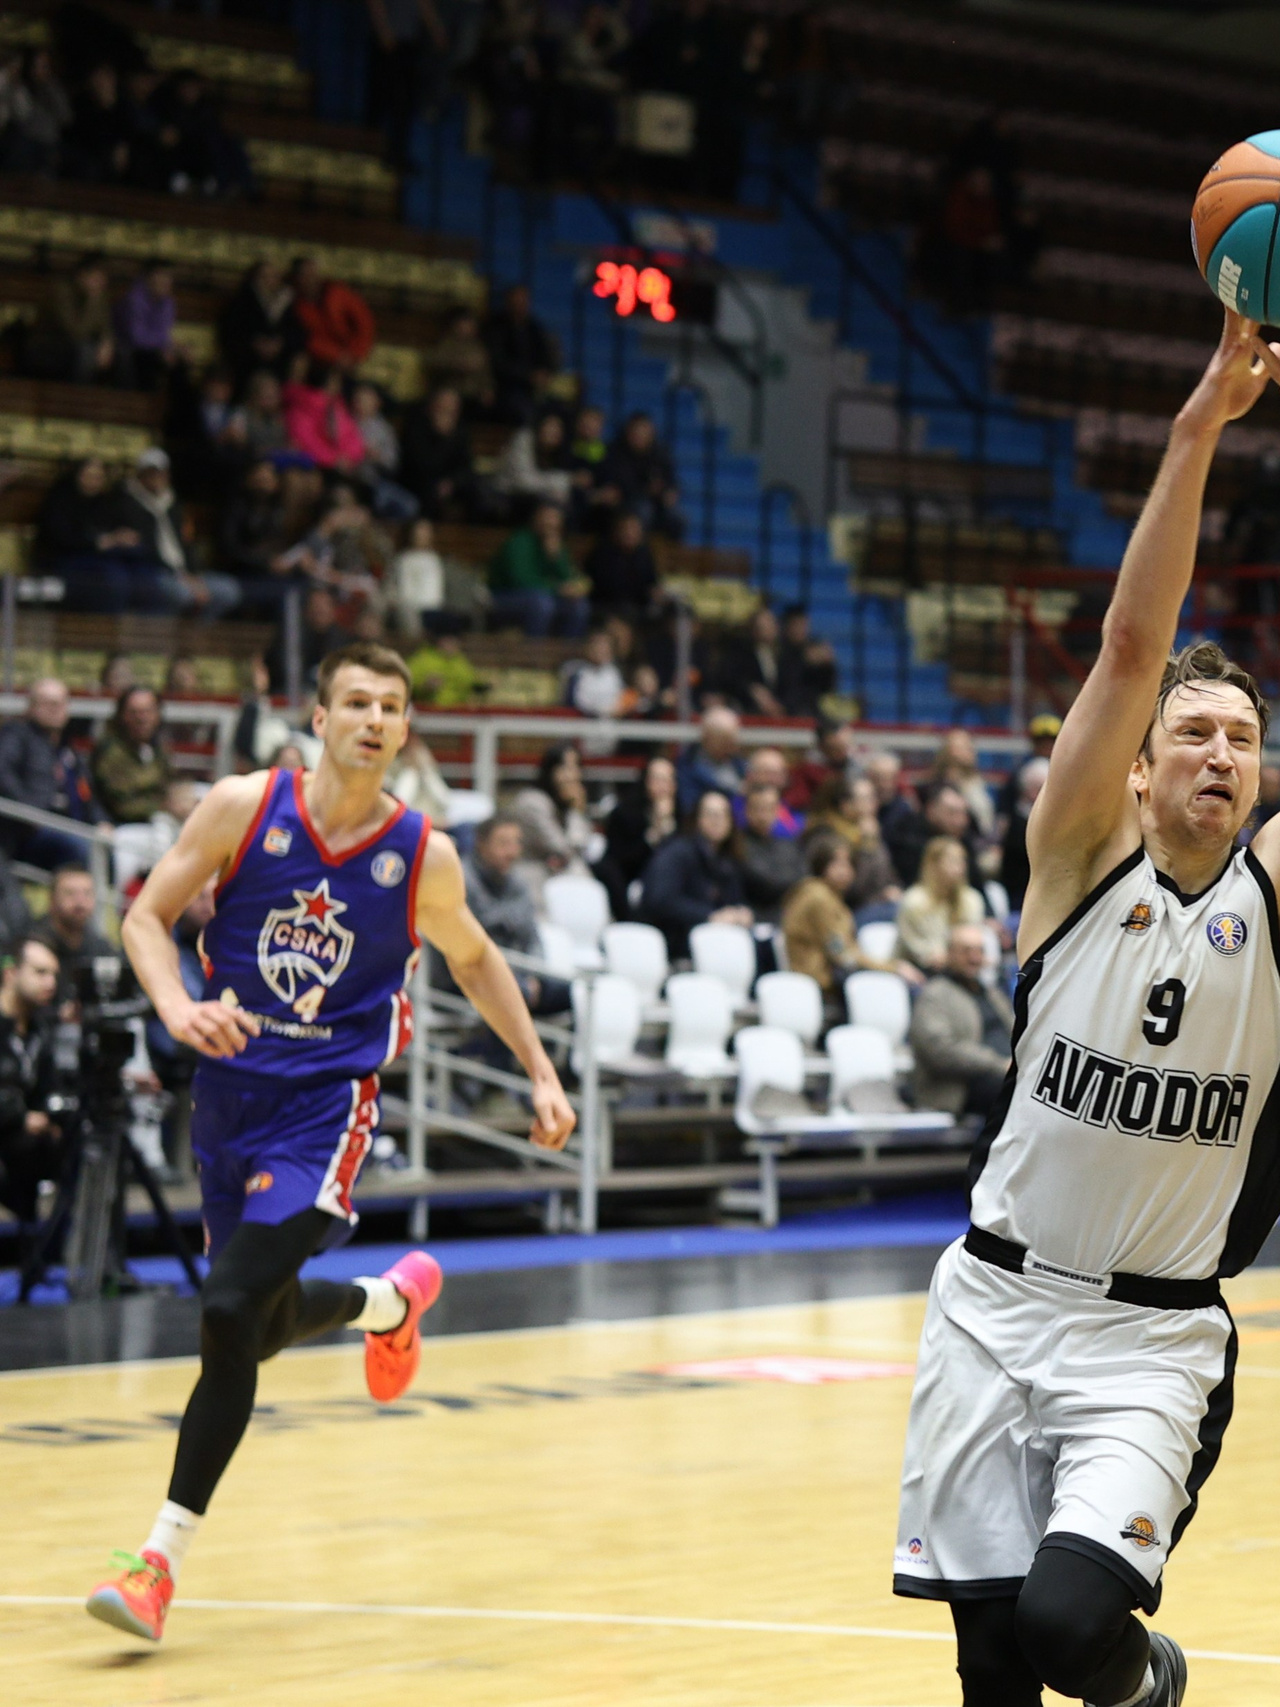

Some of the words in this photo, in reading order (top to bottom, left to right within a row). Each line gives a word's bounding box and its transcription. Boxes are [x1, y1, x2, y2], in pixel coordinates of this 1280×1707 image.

[273, 922, 338, 963] CSKA
[292, 984, 328, 1023] 4
[1142, 977, 1187, 1047] 9
[1031, 1032, 1251, 1147] AVTODOR
